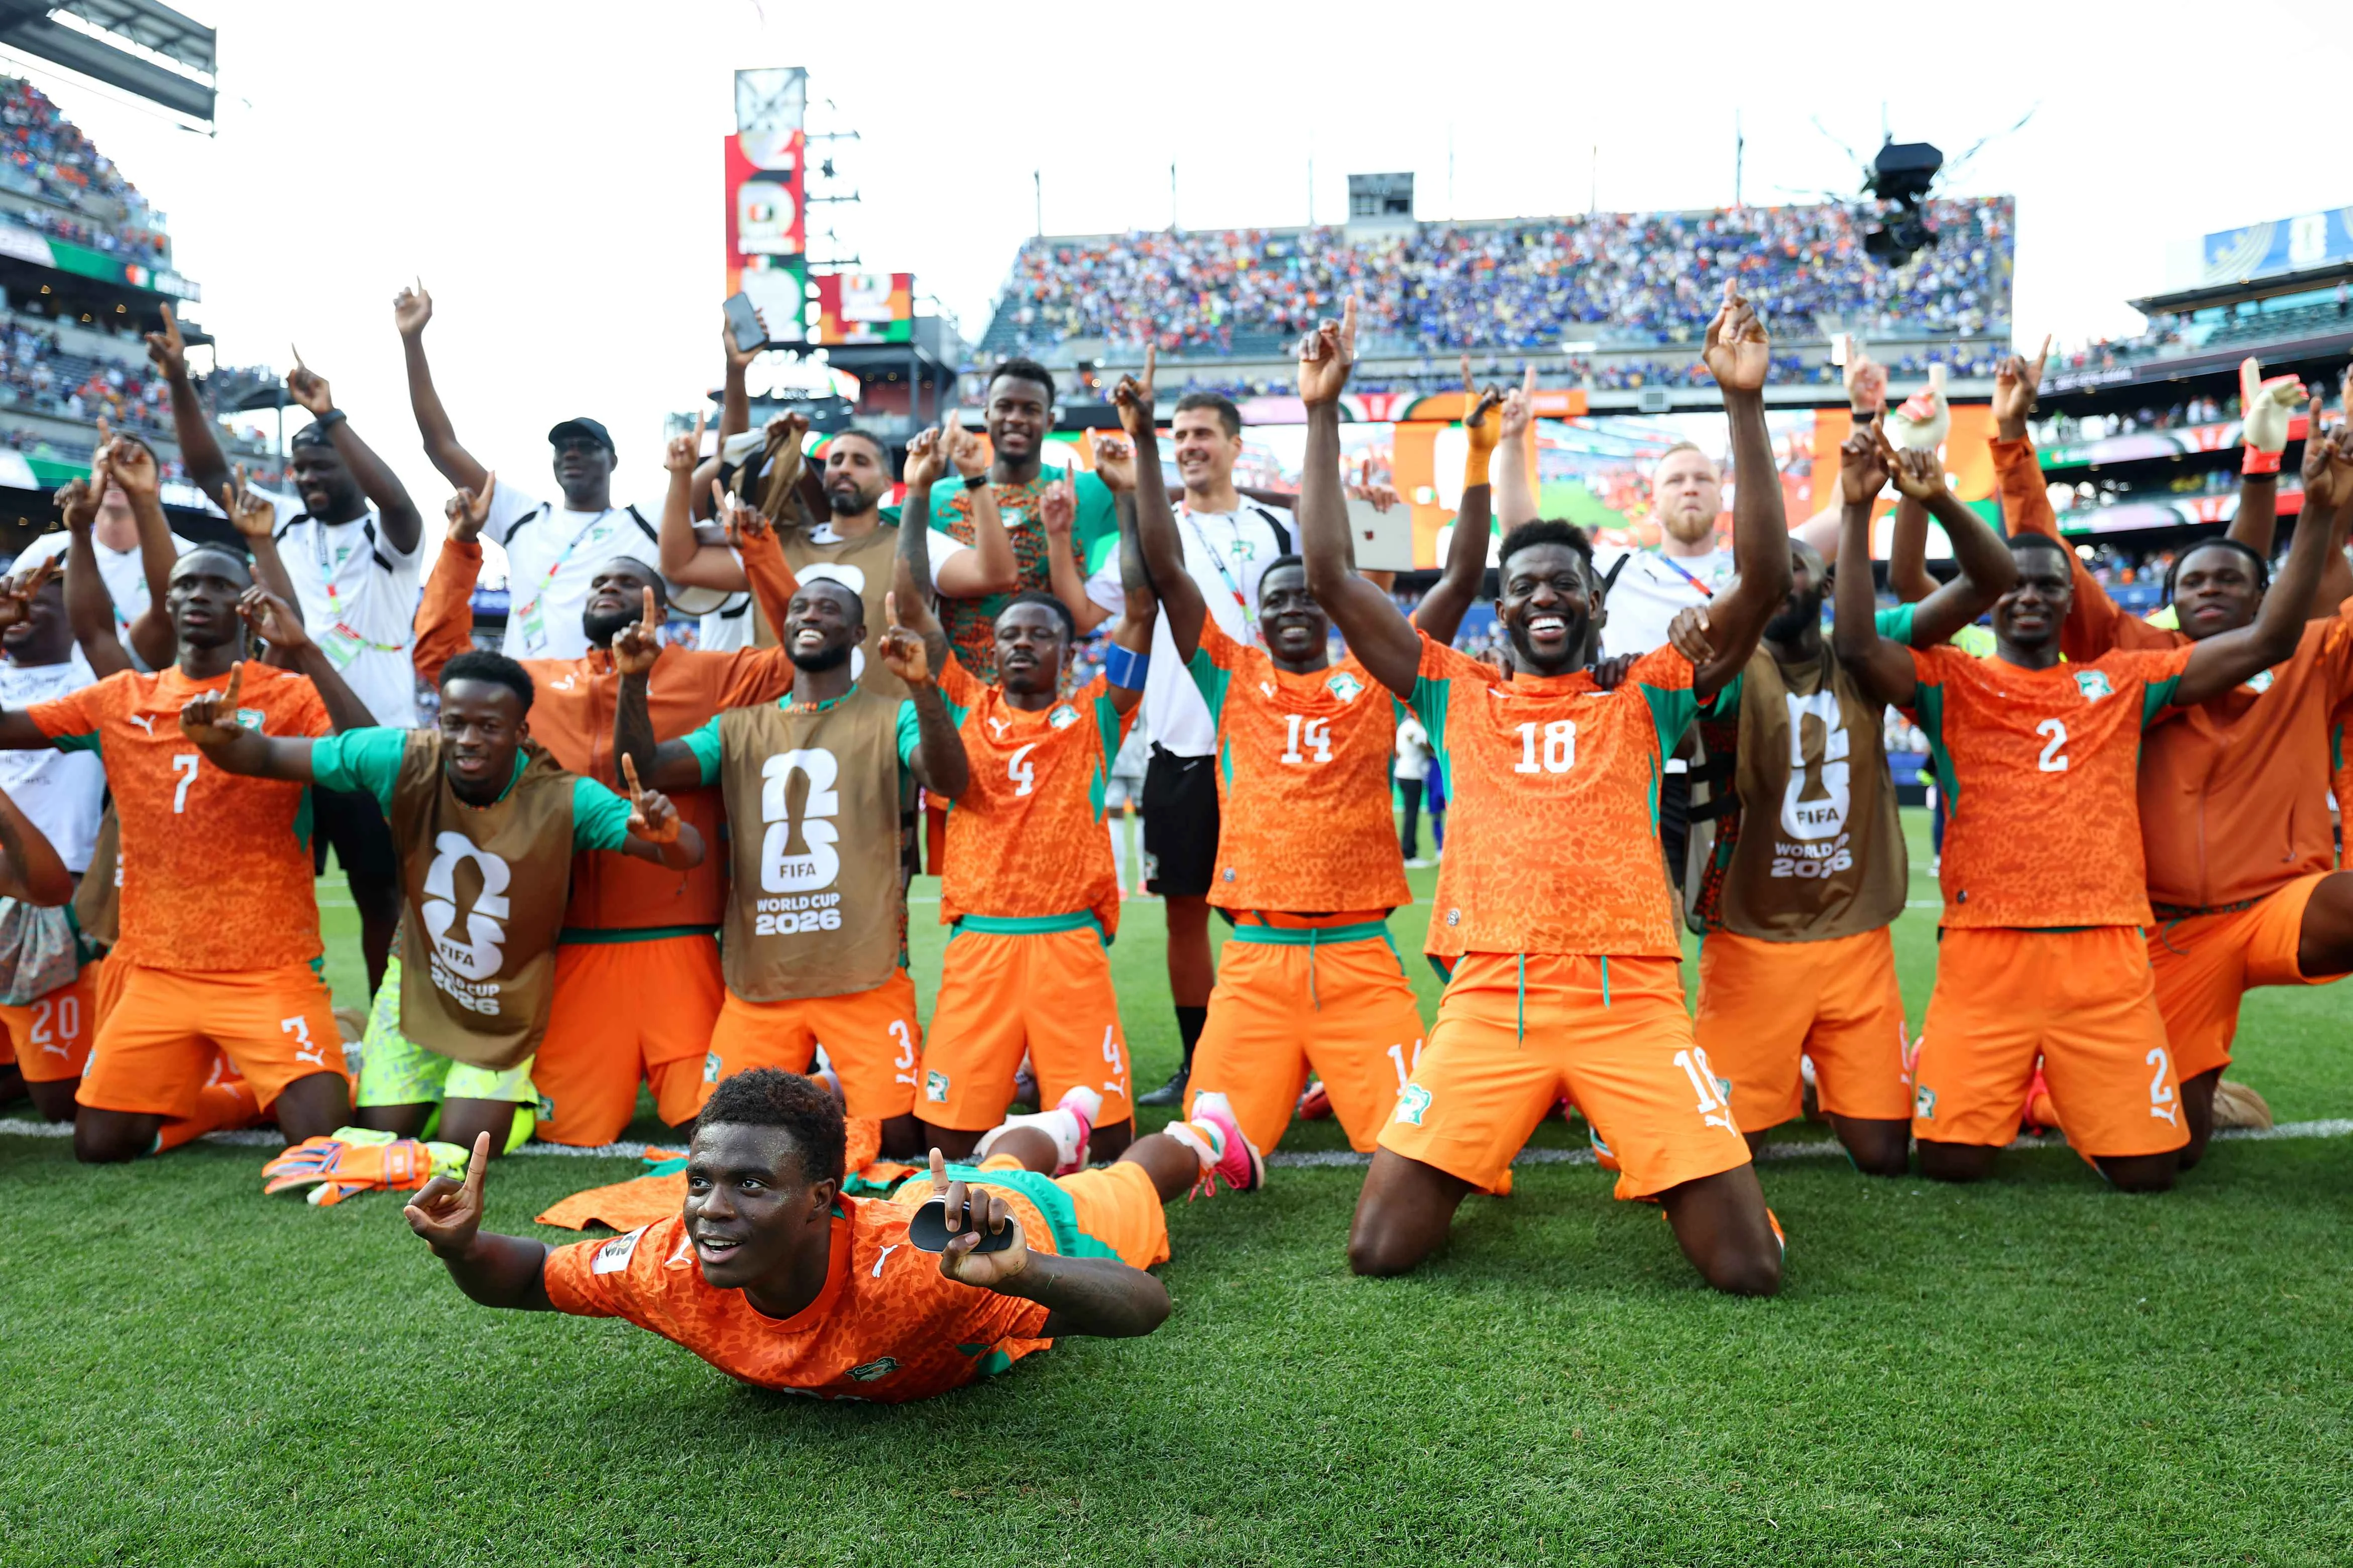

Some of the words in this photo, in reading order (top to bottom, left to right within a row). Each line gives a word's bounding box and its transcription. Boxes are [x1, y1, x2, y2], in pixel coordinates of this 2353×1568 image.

[1281, 714, 1333, 764] 14
[1514, 719, 1577, 774] 18
[2036, 718, 2069, 772] 2
[173, 755, 199, 813] 7
[1008, 743, 1037, 797] 4
[1796, 807, 1839, 825] FIFA
[780, 862, 816, 879] FIFA
[1775, 841, 1833, 858] WORLD
[755, 908, 842, 936] 2026
[757, 896, 810, 912] WORLD
[811, 892, 841, 908] CUP
[440, 943, 474, 968] FIFA
[431, 964, 500, 1016] 2026
[467, 983, 500, 997] CUP
[30, 996, 80, 1044] 20
[281, 1015, 313, 1051] 7
[888, 1019, 914, 1069] 3
[1102, 1025, 1124, 1075] 4
[2146, 1046, 2173, 1105] 2
